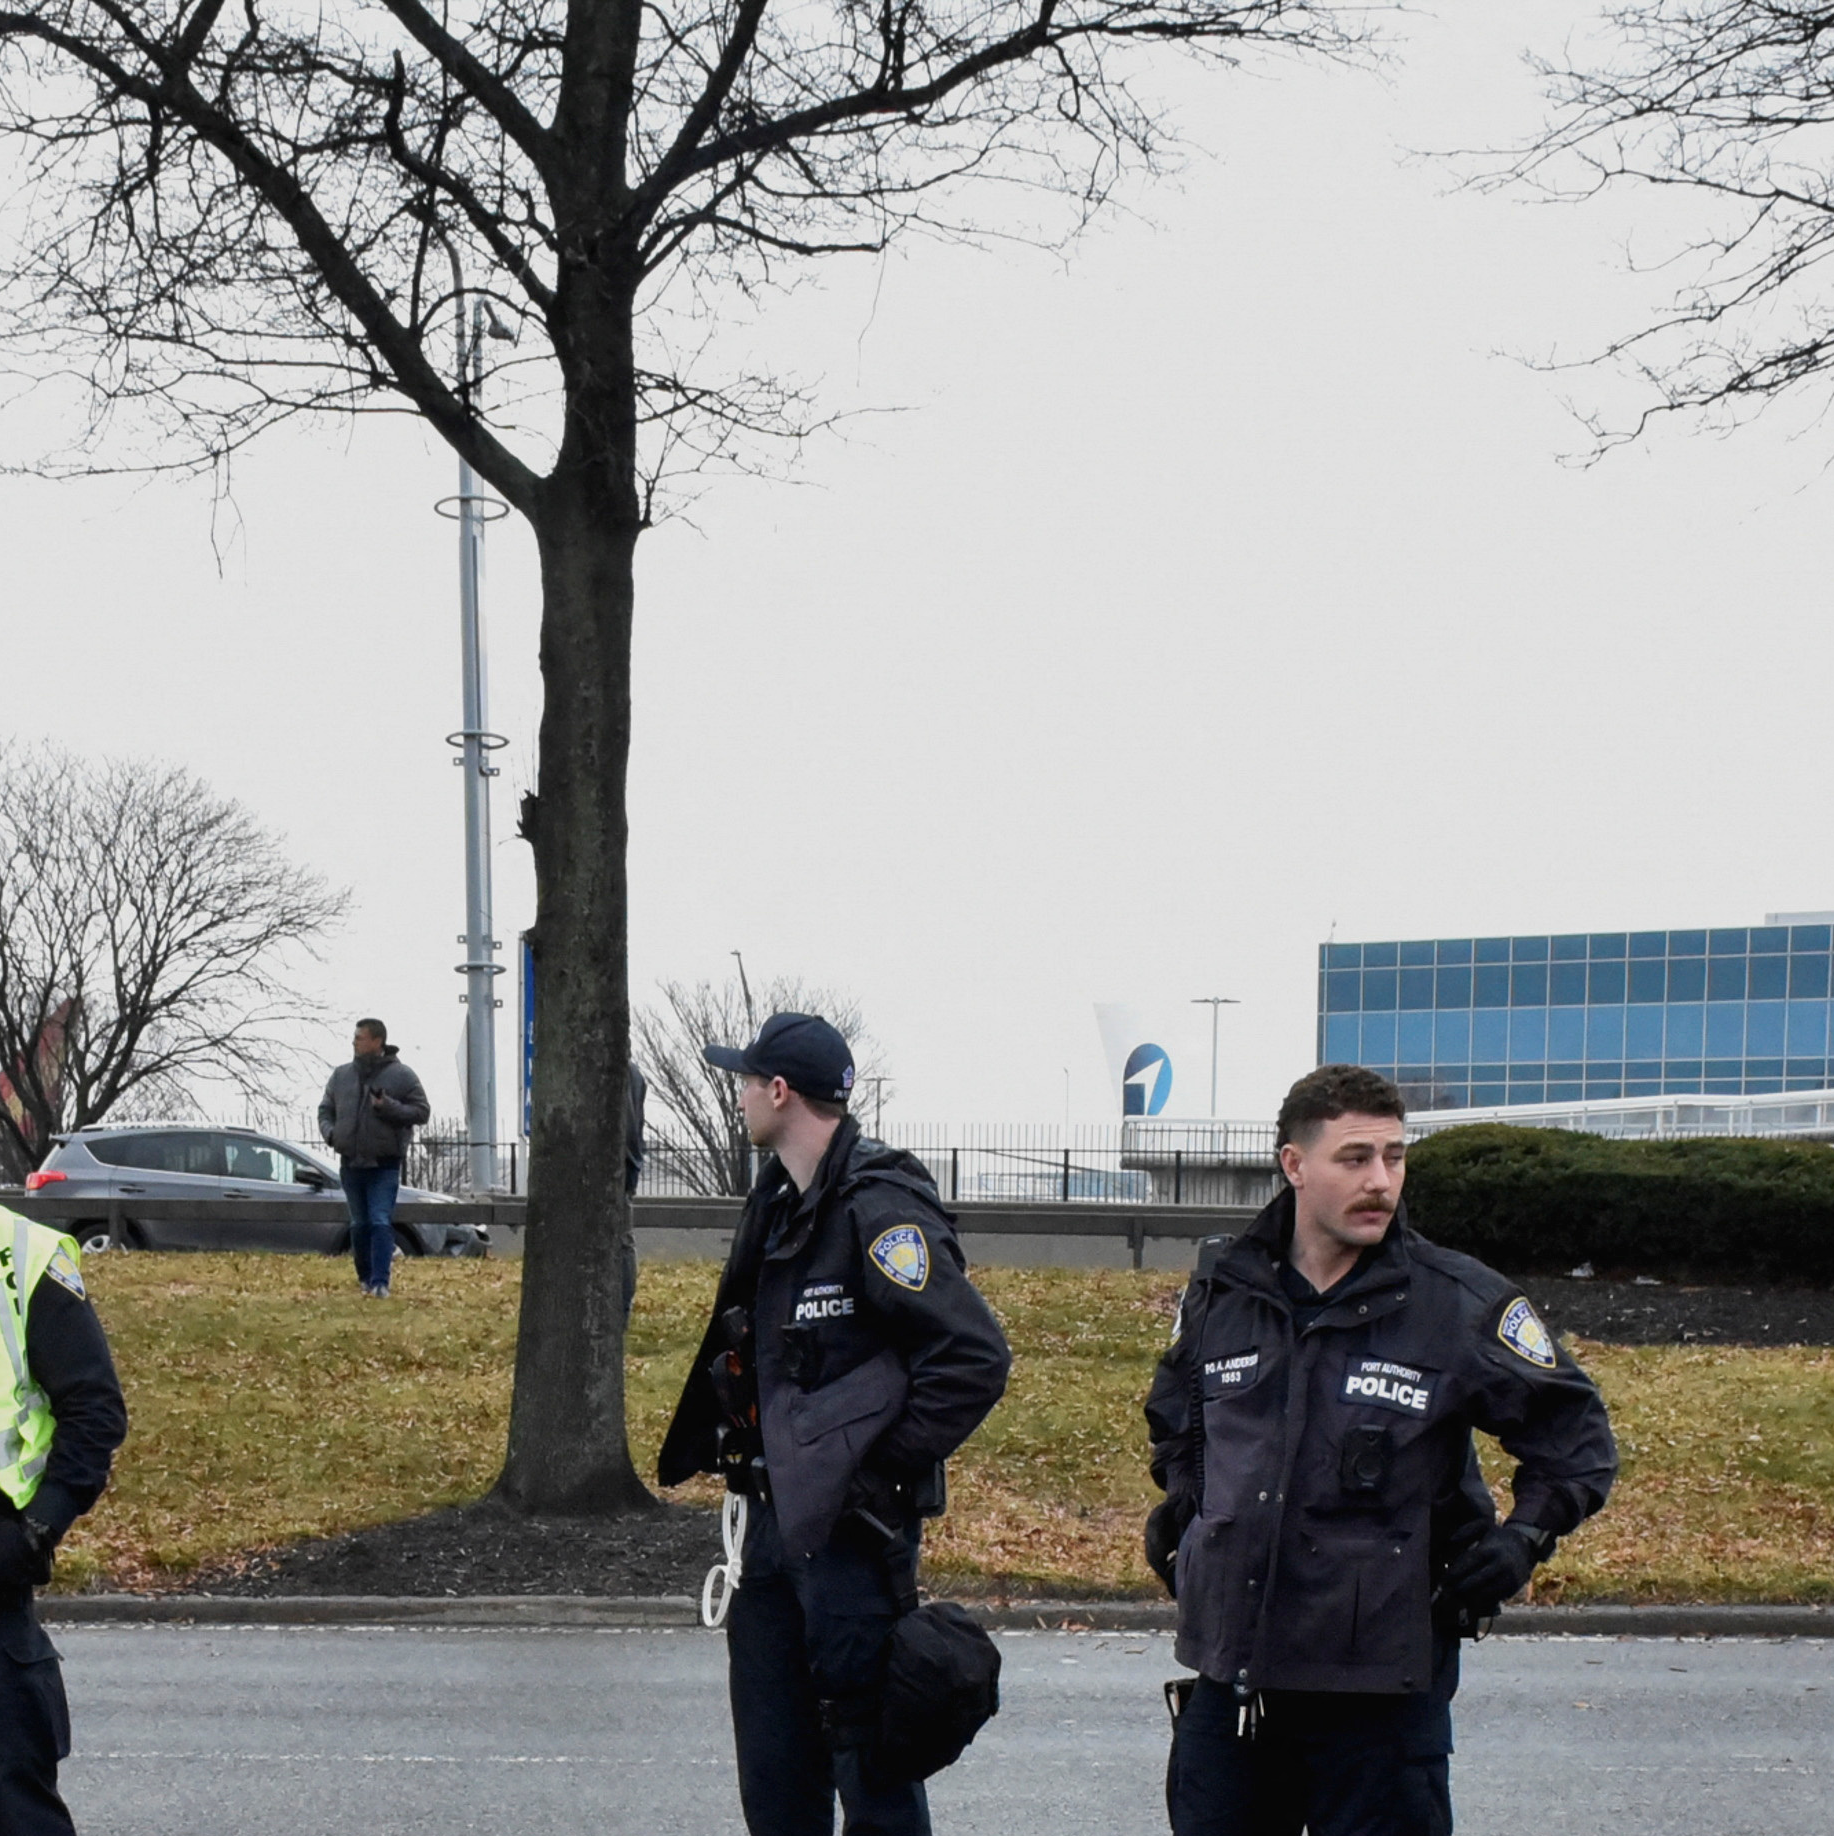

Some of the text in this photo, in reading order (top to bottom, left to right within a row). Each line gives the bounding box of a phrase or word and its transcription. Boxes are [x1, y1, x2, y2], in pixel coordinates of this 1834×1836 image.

[877, 1233, 915, 1257] POLICE
[796, 1297, 854, 1321] POLICE
[1361, 1361, 1423, 1382] PORT AUTHORITY
[1346, 1375, 1429, 1410] POLICE
